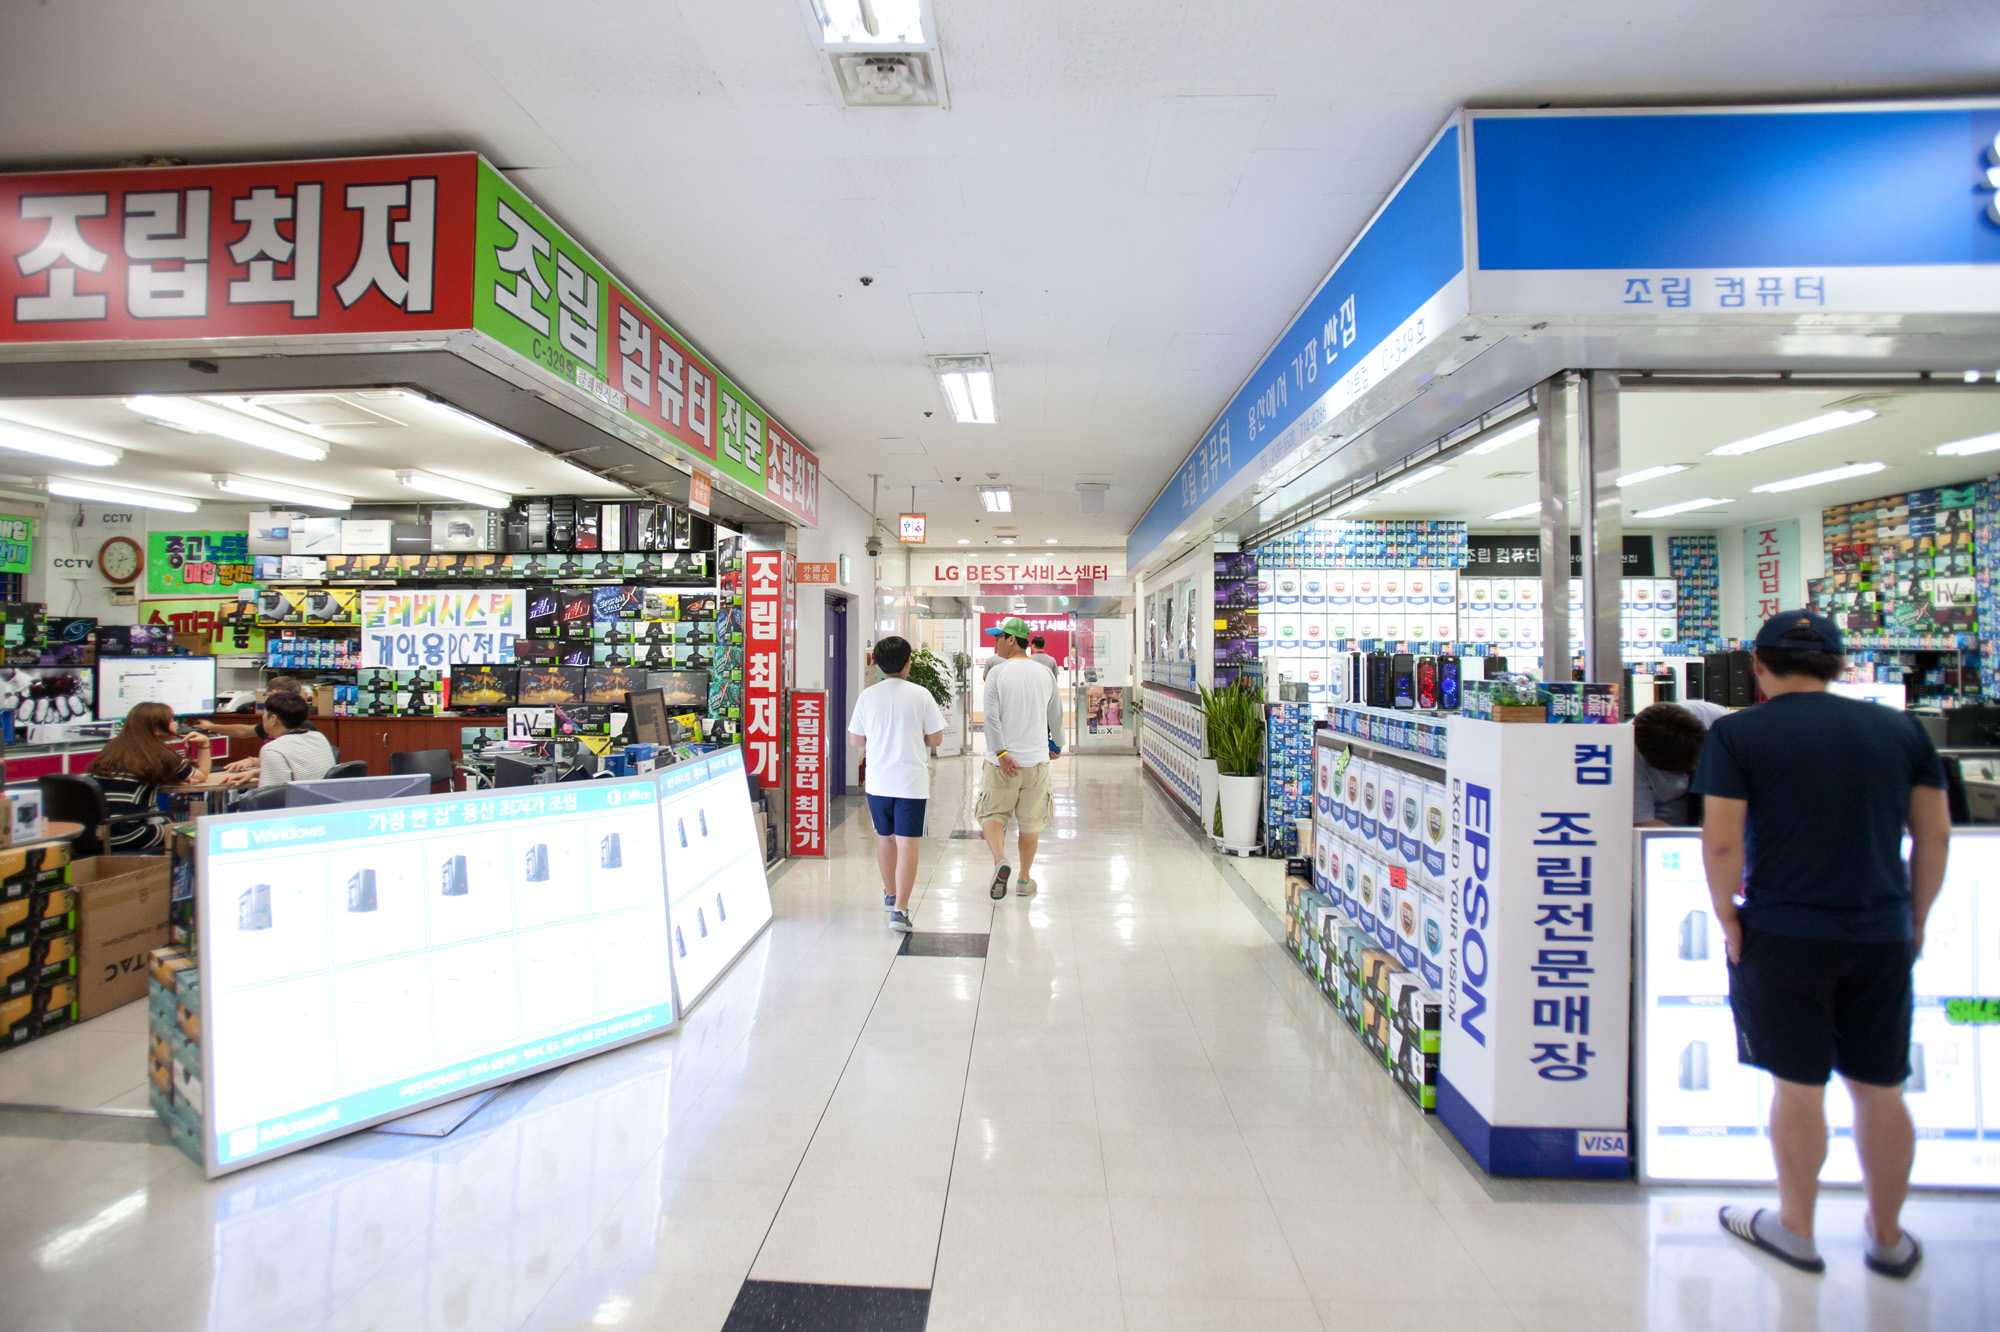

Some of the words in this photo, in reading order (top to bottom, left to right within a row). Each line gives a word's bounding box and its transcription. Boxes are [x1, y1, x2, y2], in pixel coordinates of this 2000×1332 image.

[14, 176, 440, 324] 조립최저
[1624, 277, 1692, 308] 조립
[1715, 275, 1826, 308] 컴퓨터
[494, 196, 599, 371] 조립
[618, 302, 711, 449] 컴퓨터
[721, 388, 762, 476] 전문
[767, 427, 817, 519] 조립최저
[533, 338, 574, 380] C-329호
[1181, 460, 1197, 509] 조립
[1199, 418, 1232, 494] 컴퓨터
[1248, 371, 1288, 441] 용산에서
[1291, 337, 1318, 391] 가장
[103, 513, 133, 523] CCTV
[54, 558, 94, 569] CCTV
[803, 564, 830, 573] 外國人
[935, 565, 959, 581] LG
[1496, 548, 1541, 564] 컴퓨터
[803, 573, 830, 582] 免稅店
[364, 593, 514, 629] 클레버시스템
[1553, 693, 1566, 716] CORE
[1588, 694, 1597, 716] CORE
[795, 699, 820, 790] 조립컴퓨터
[1574, 744, 1613, 786] 컴
[368, 811, 406, 833] 가장
[408, 810, 430, 829] 싼
[461, 800, 496, 823] 용산
[498, 796, 548, 819] 최저가
[549, 792, 578, 811] 조립
[622, 788, 651, 803] Office
[251, 825, 327, 844] Windows
[795, 795, 820, 849] 최저가
[1450, 777, 1461, 870] EXCEED
[1449, 877, 1460, 940] YOUR
[1460, 782, 1491, 1049] EPSON
[1530, 810, 1598, 1082] 조립전문매장
[1448, 948, 1459, 1023] VISION
[1946, 998, 2000, 1025] SALE
[469, 1065, 489, 1077] 100%
[260, 1106, 340, 1143] Microsoft
[1582, 1136, 1625, 1152] VISA
